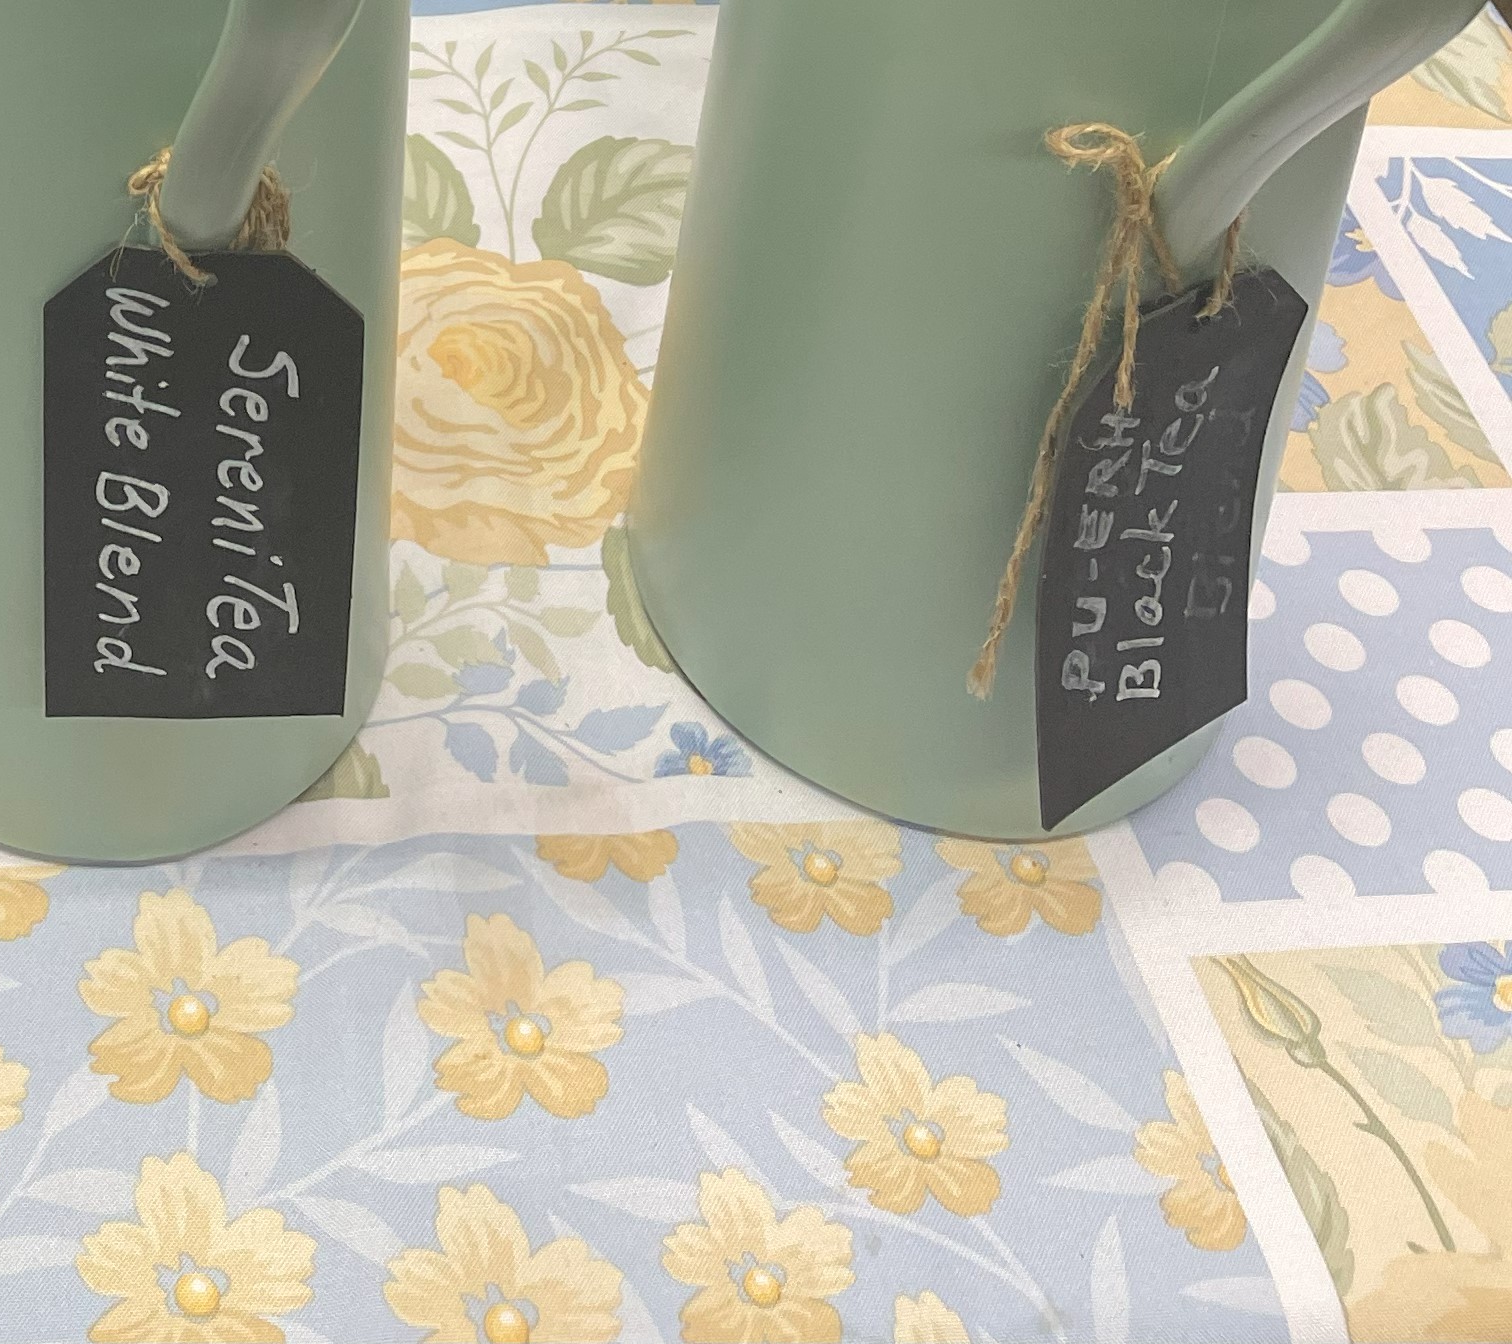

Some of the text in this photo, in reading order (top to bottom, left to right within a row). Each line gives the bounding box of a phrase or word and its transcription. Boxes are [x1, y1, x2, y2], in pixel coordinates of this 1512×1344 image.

[93, 287, 181, 676] White Blend
[1115, 365, 1219, 702] Black Tea
